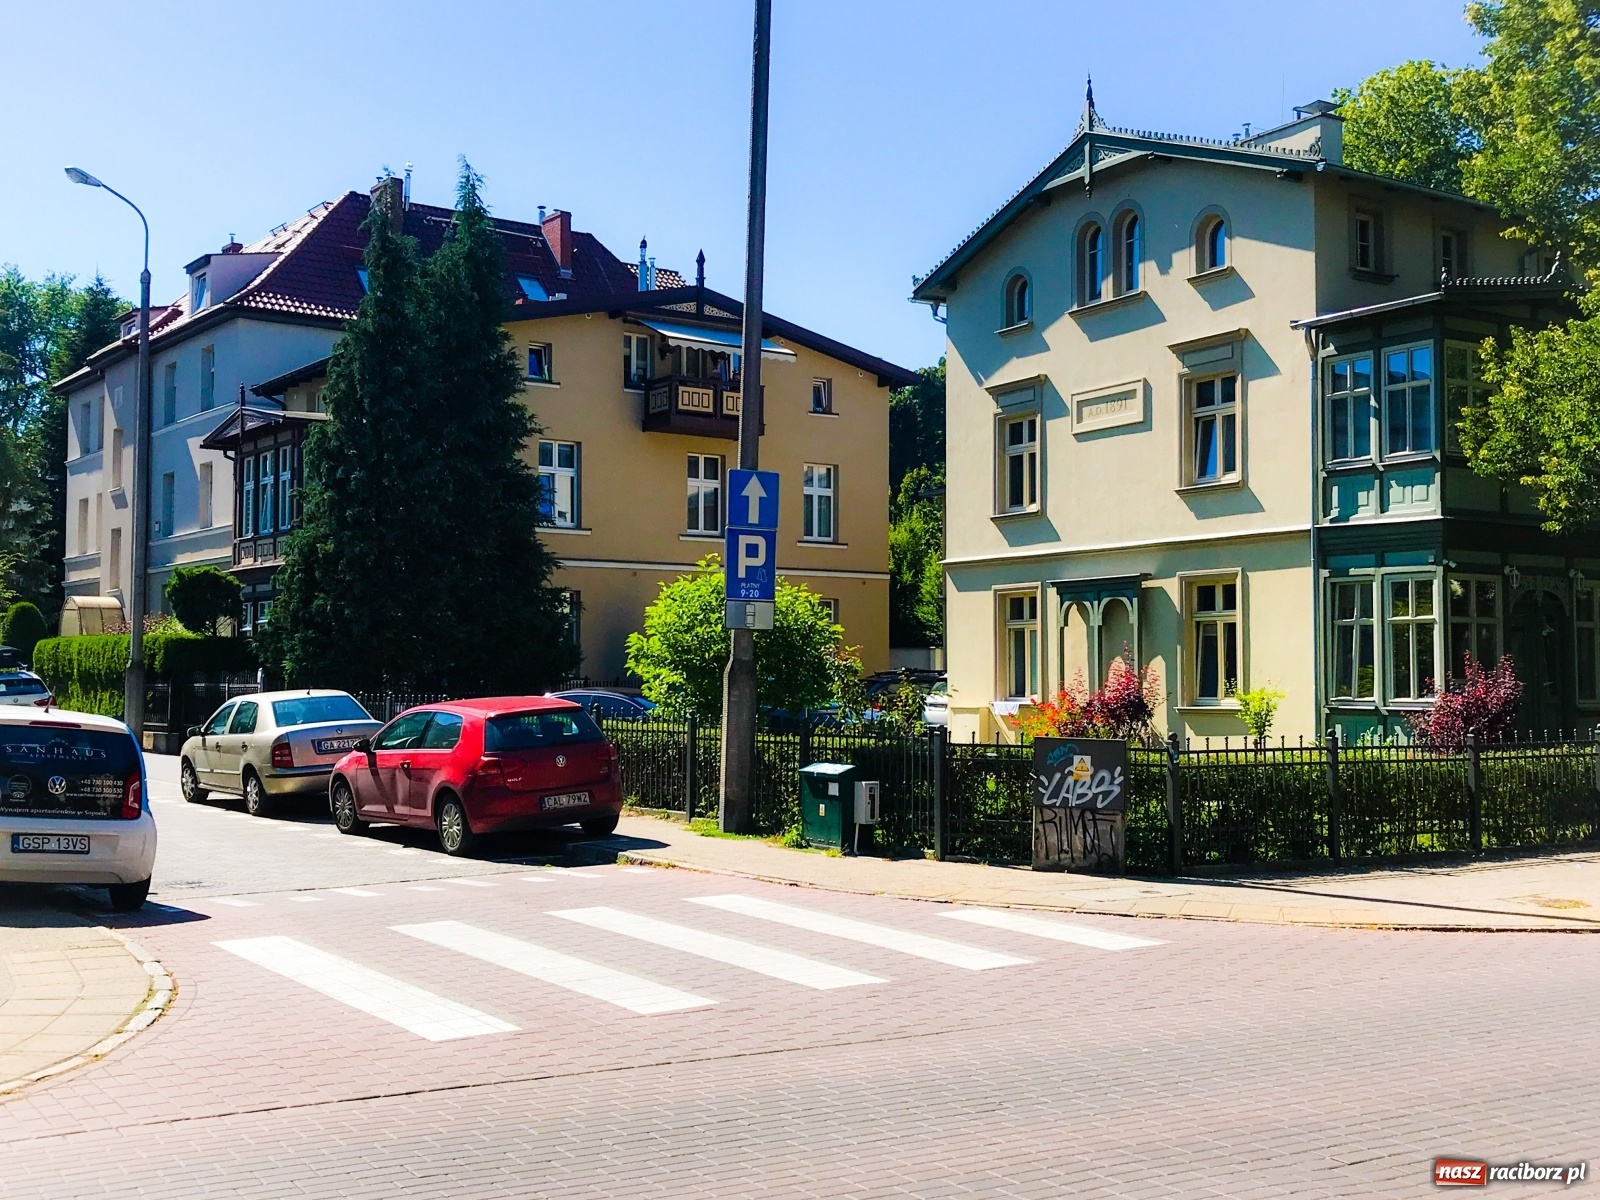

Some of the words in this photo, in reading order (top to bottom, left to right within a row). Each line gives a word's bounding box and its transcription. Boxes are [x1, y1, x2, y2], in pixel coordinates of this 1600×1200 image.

[1105, 398, 1126, 413] 1891
[737, 534, 767, 578] P
[323, 741, 335, 750] GA
[6, 746, 107, 758] SANHAUS
[546, 798, 564, 807] CAL
[22, 837, 50, 849] GSP
[56, 838, 87, 850] 13VS
